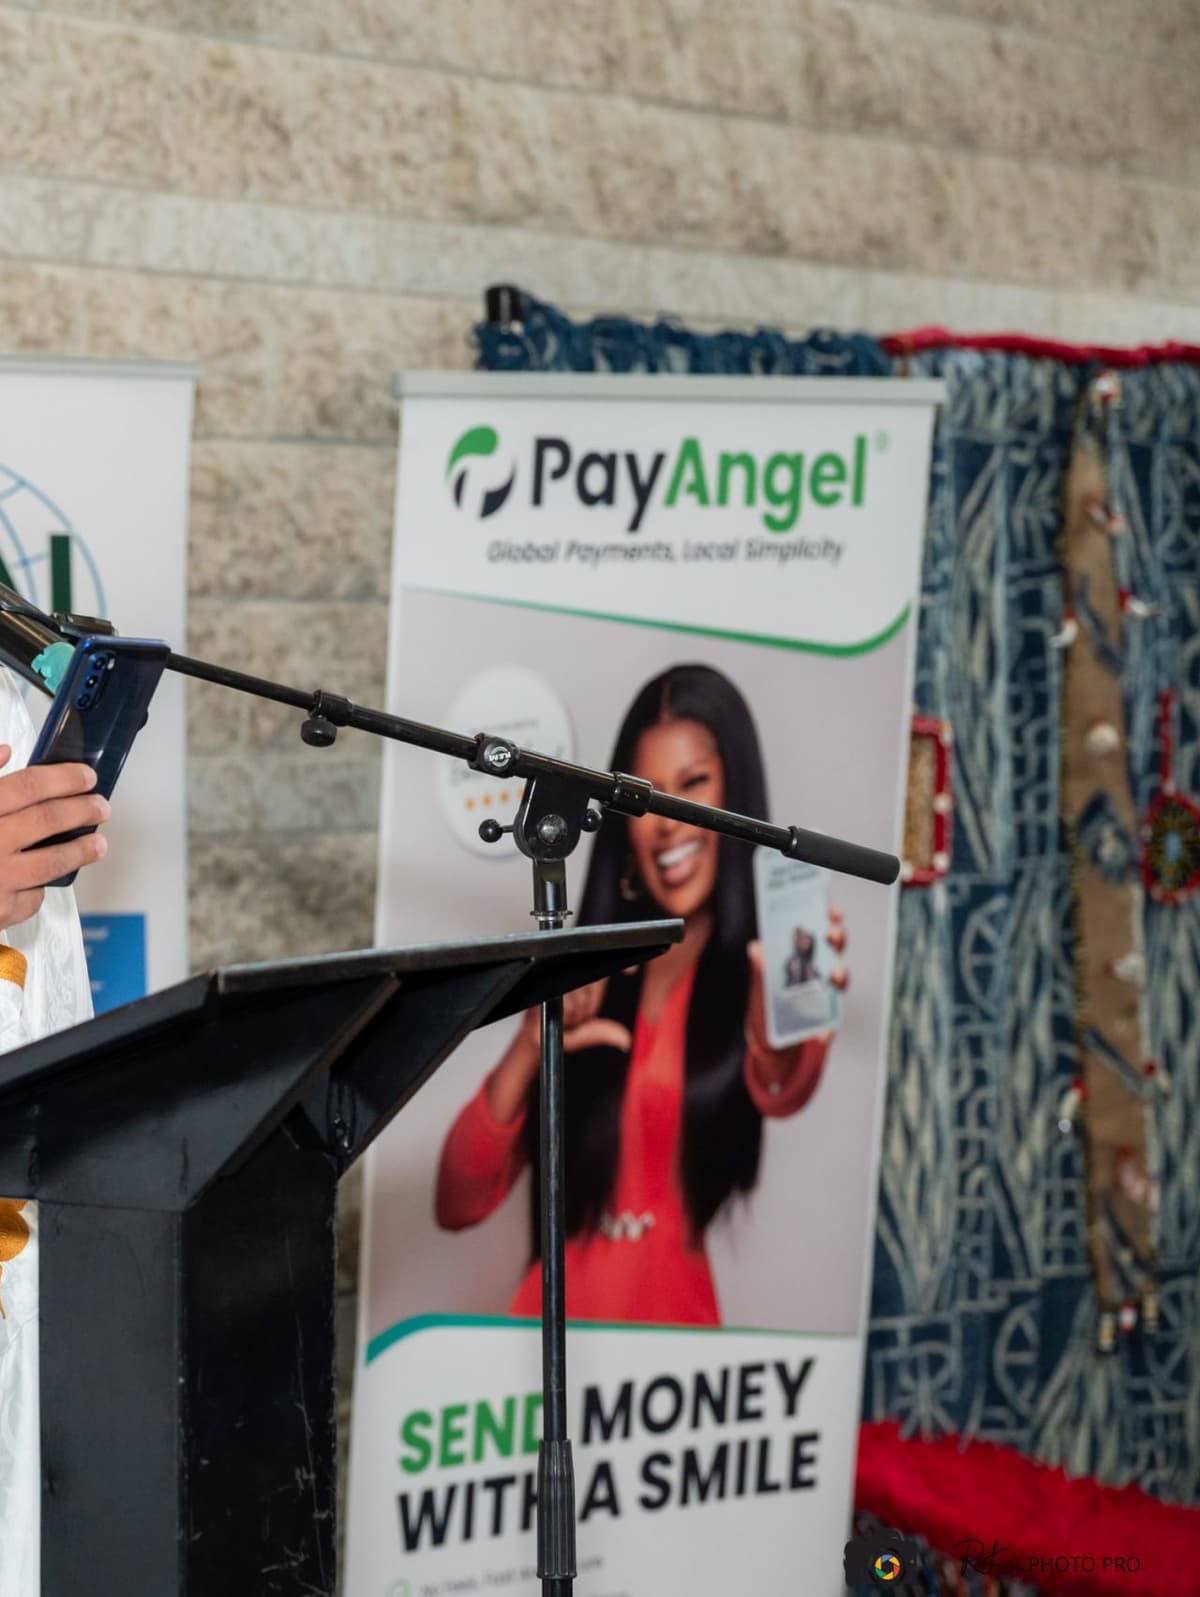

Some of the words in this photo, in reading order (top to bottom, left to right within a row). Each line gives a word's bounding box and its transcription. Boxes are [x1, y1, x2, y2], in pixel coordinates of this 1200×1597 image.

[530, 435, 867, 533] PayAngel
[487, 538, 559, 563] Global
[682, 537, 740, 563] Local
[745, 537, 845, 568] Simplicity
[580, 1357, 816, 1446] MONEY
[577, 1460, 621, 1523] A
[638, 1432, 821, 1512] SMILE
